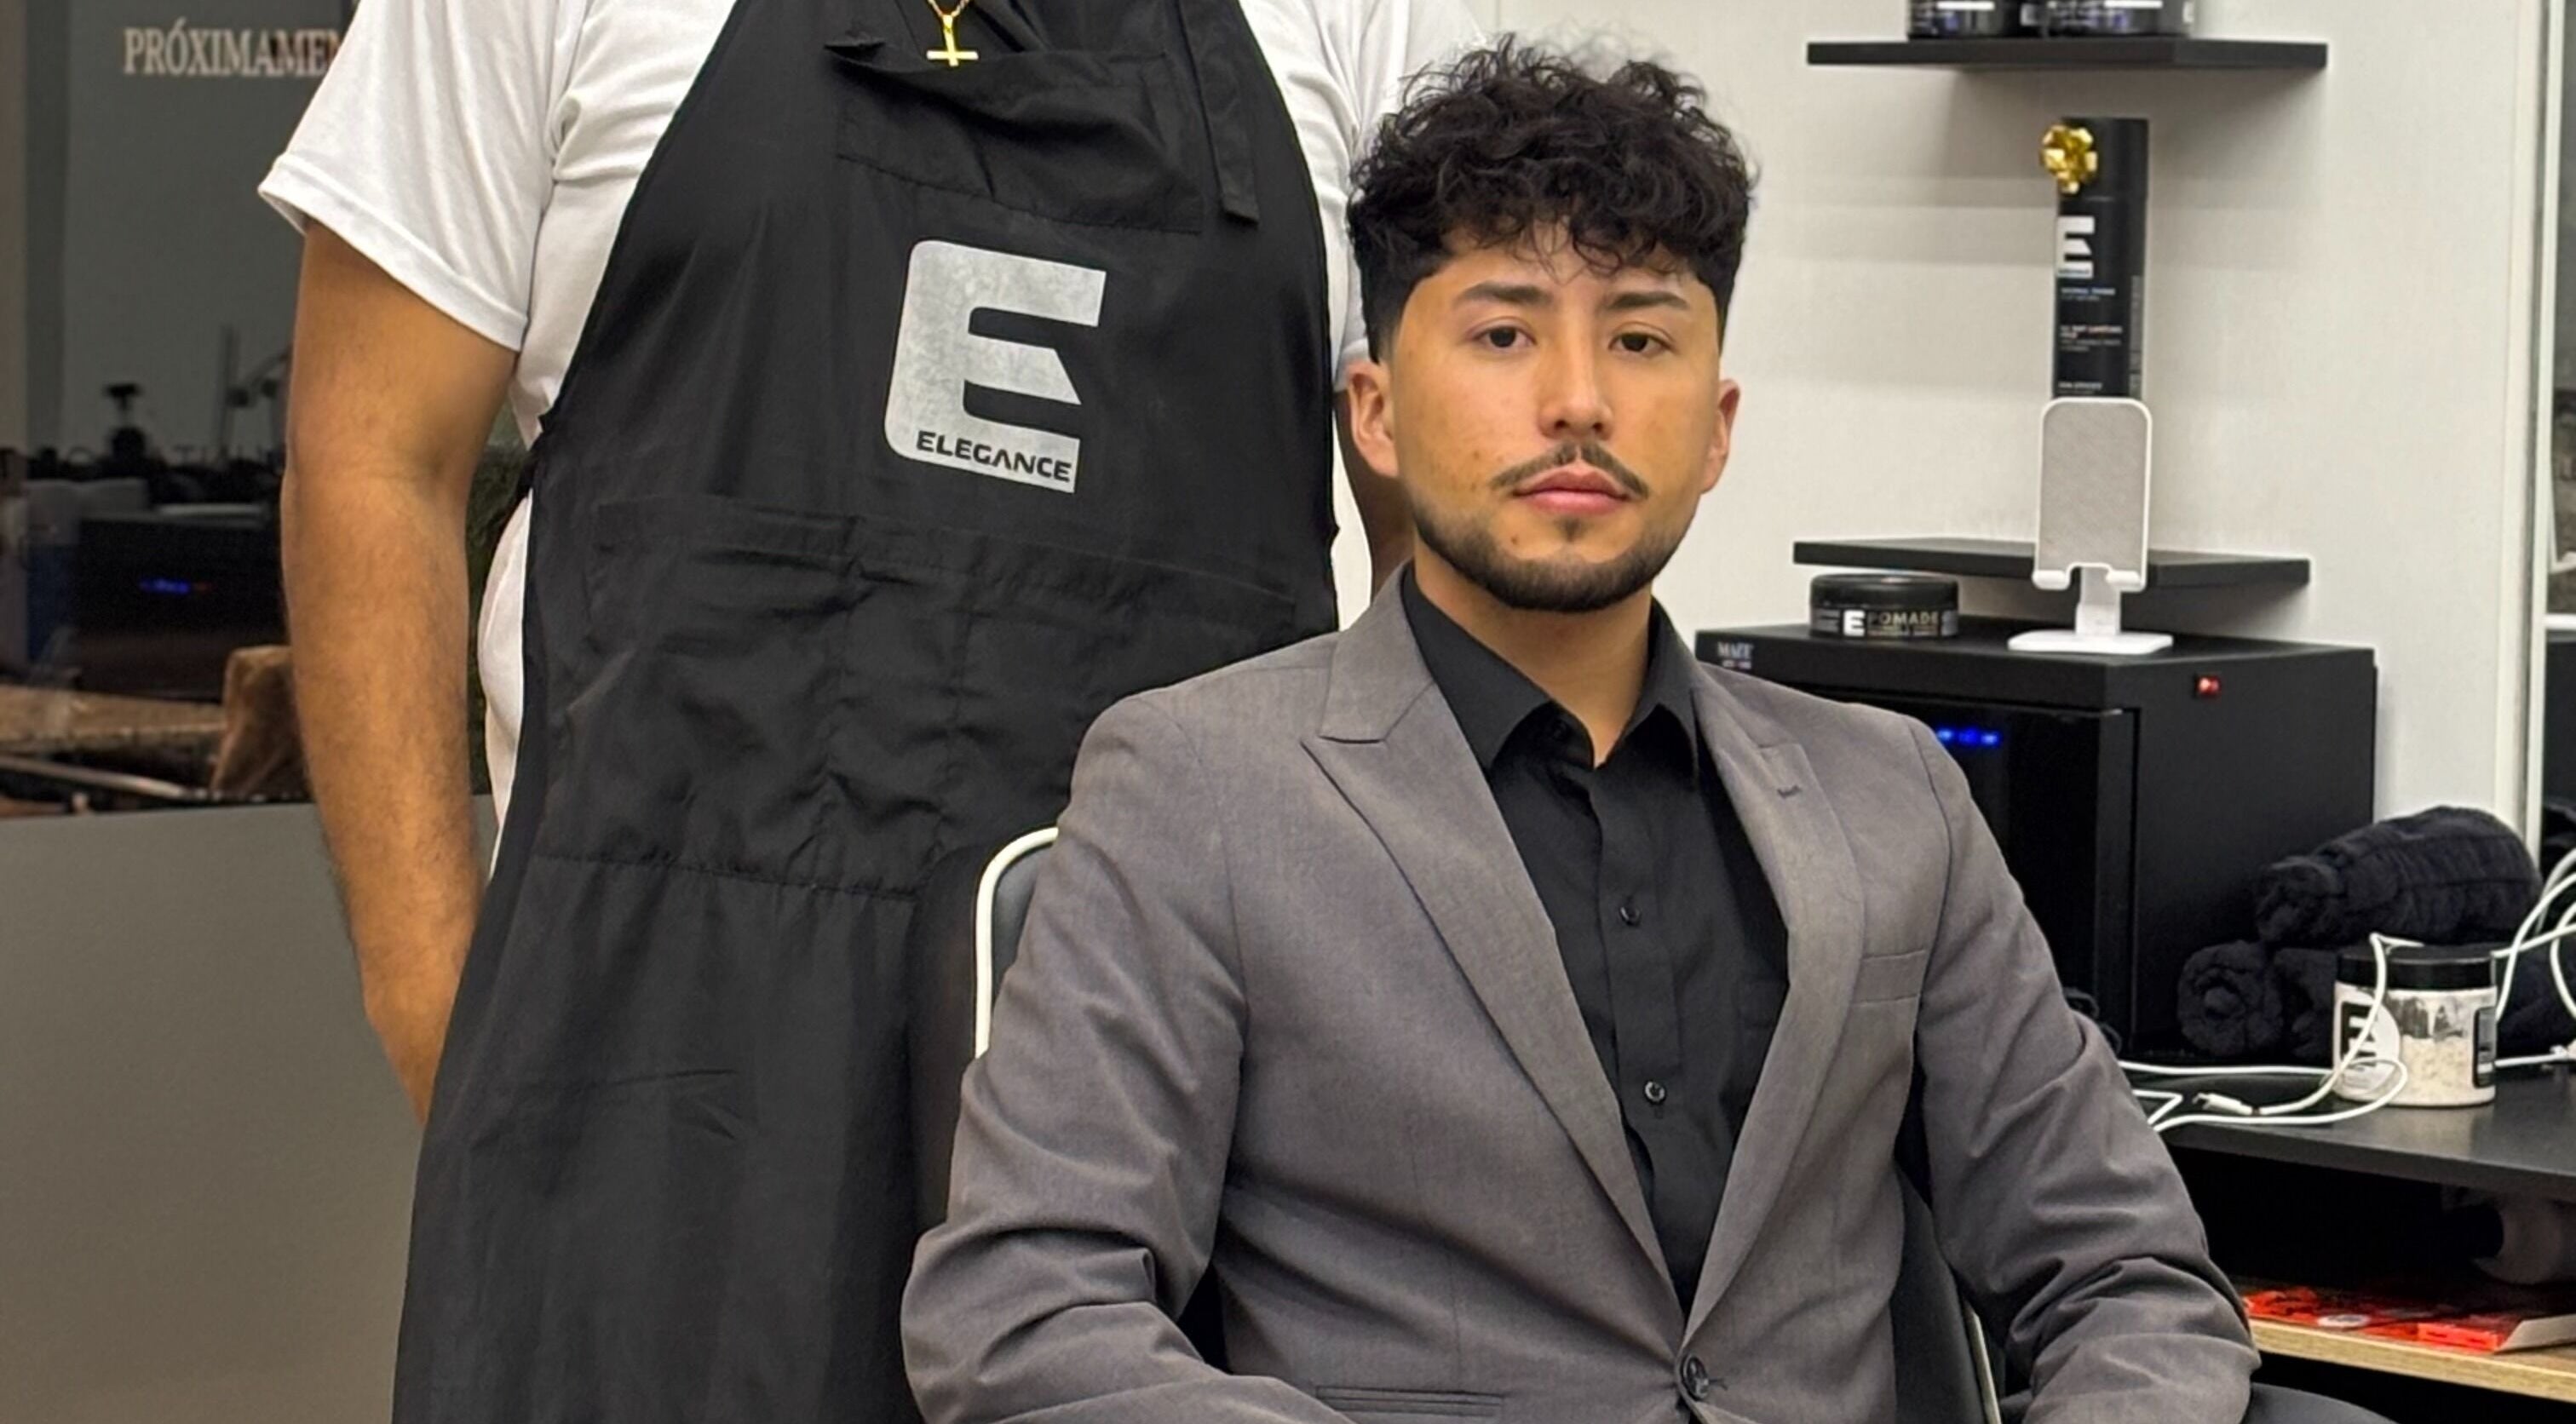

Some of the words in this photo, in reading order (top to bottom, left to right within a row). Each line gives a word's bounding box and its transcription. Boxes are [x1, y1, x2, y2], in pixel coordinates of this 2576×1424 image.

[884, 239, 1107, 493] E
[916, 430, 1072, 483] ELEGANCE
[1843, 609, 1866, 636] E
[1866, 608, 1939, 626] POMADE
